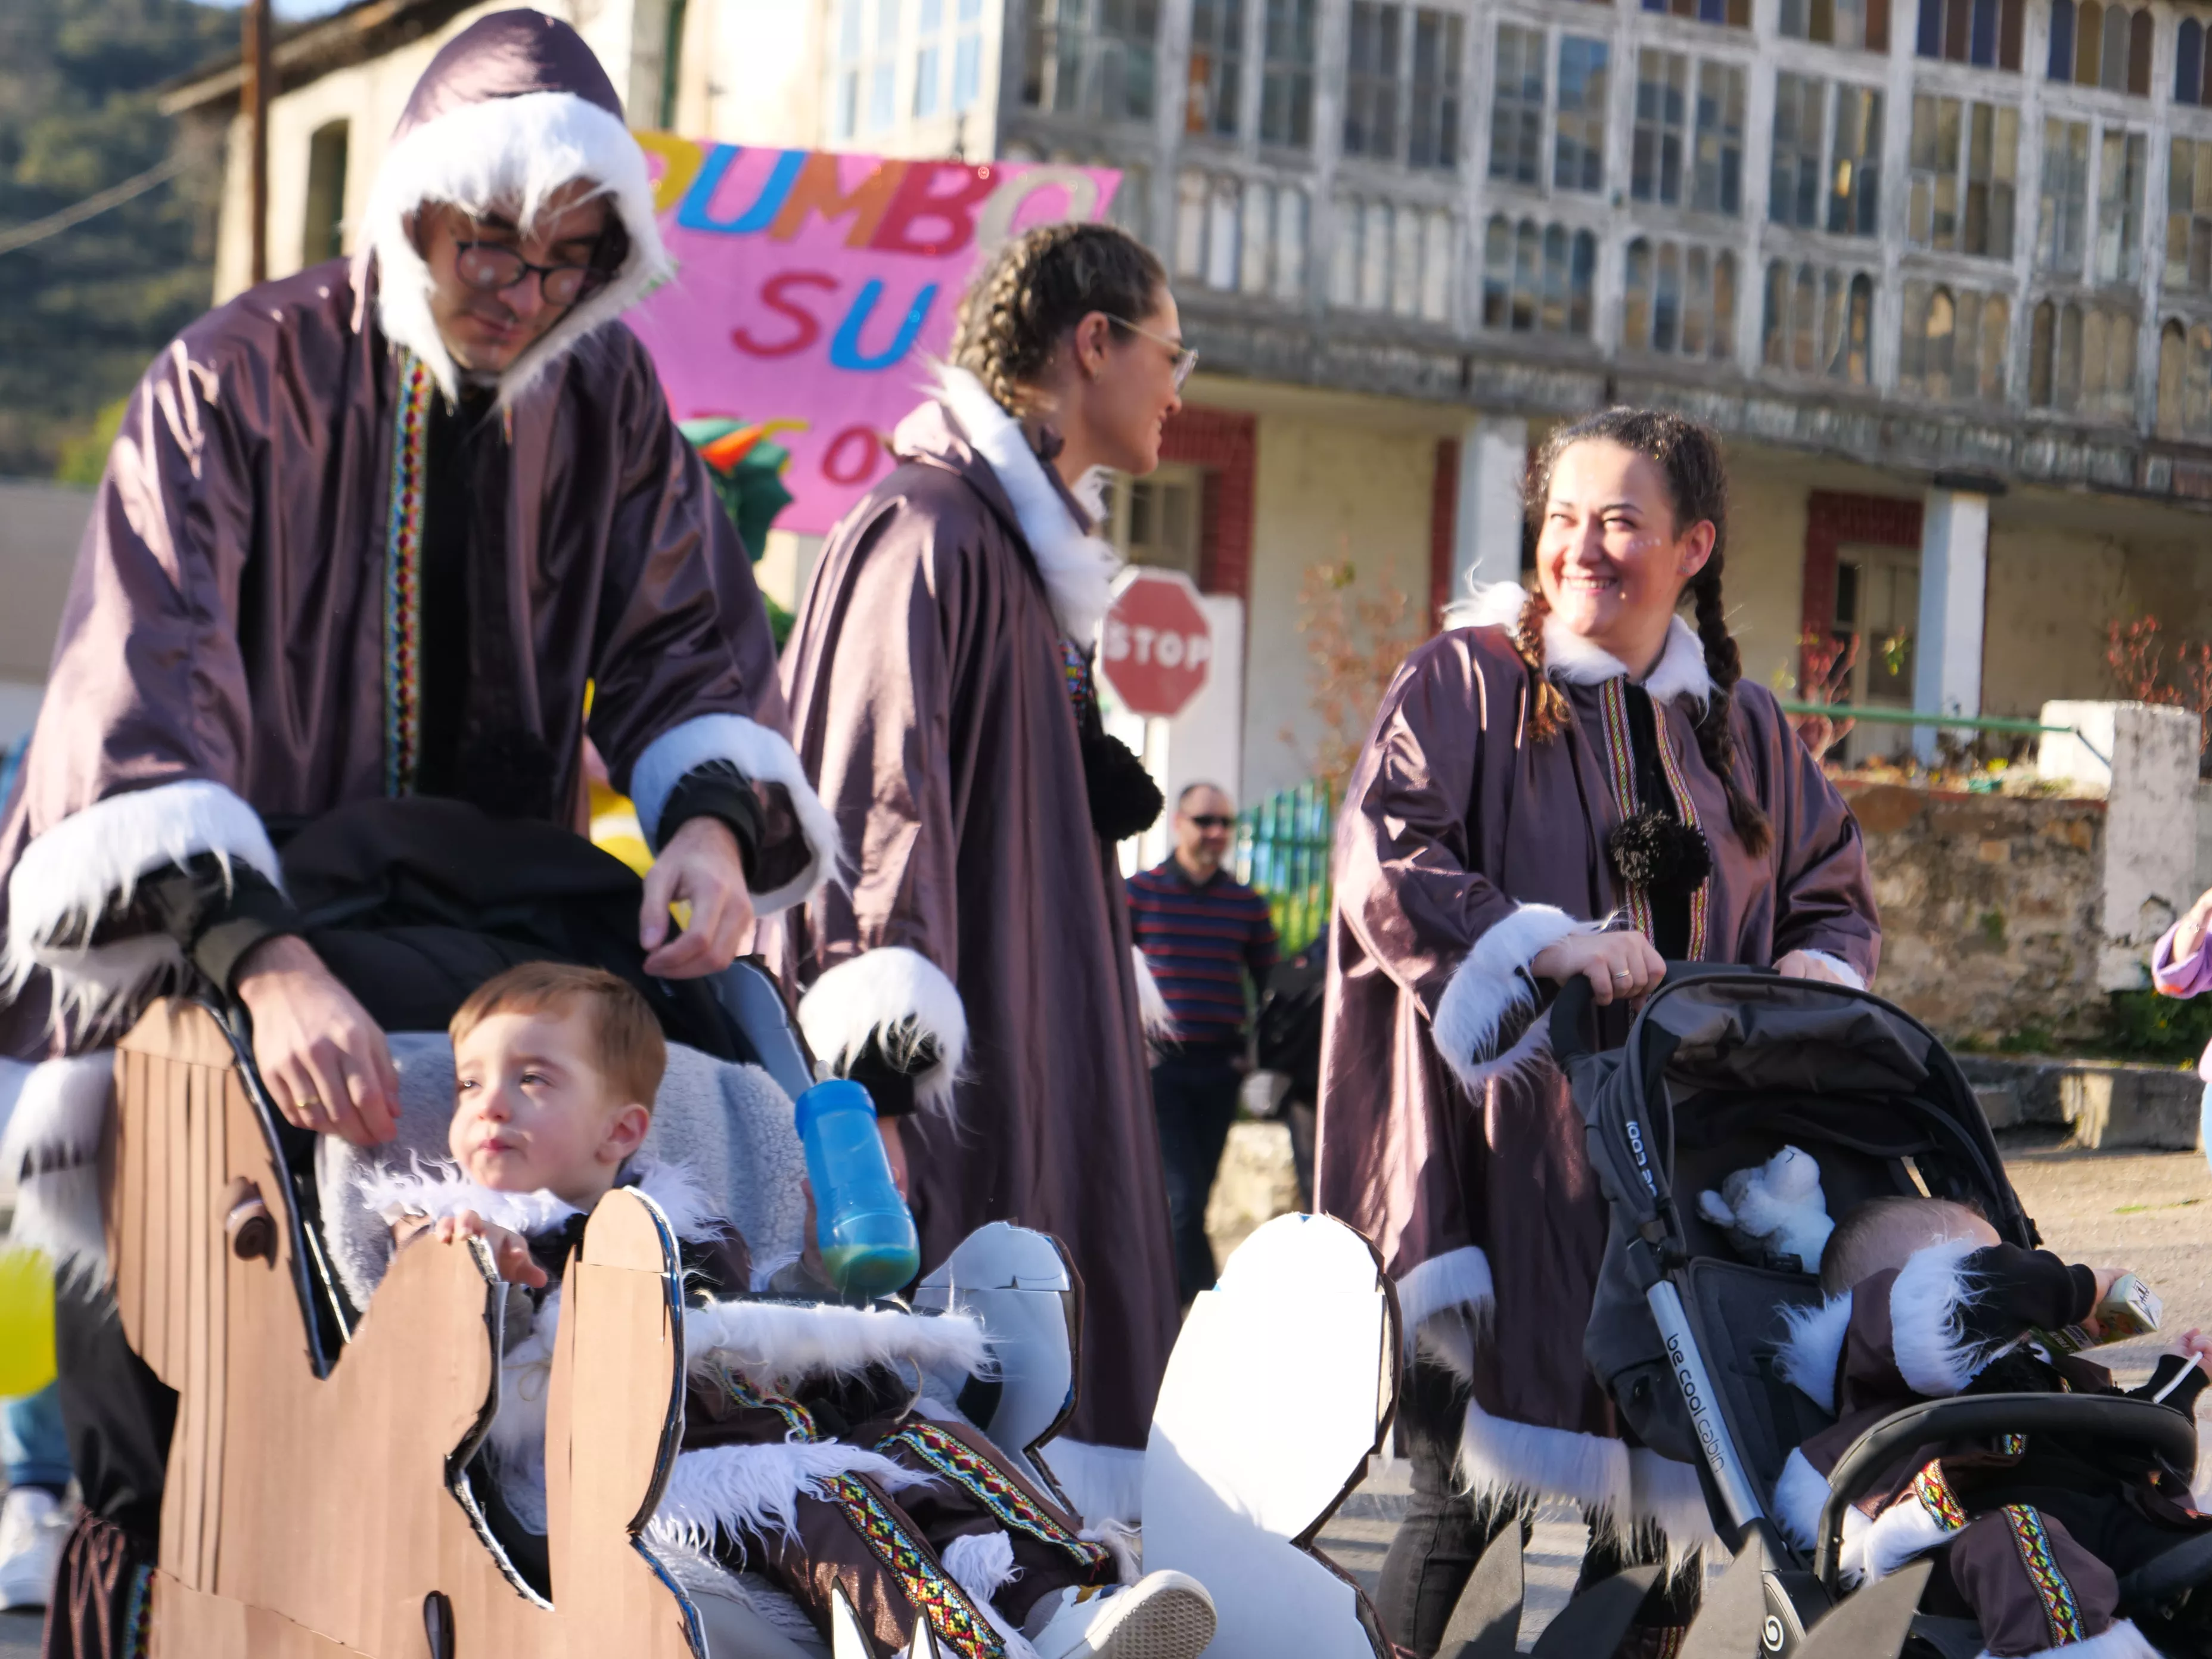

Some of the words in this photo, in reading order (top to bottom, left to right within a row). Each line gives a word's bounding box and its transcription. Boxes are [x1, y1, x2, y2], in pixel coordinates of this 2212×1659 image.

[731, 272, 939, 371] SU
[1103, 622, 1211, 672] STOP
[1667, 1332, 1685, 1367] be
[1679, 1369, 1707, 1417] cool
[1698, 1418, 1725, 1473] cabin
